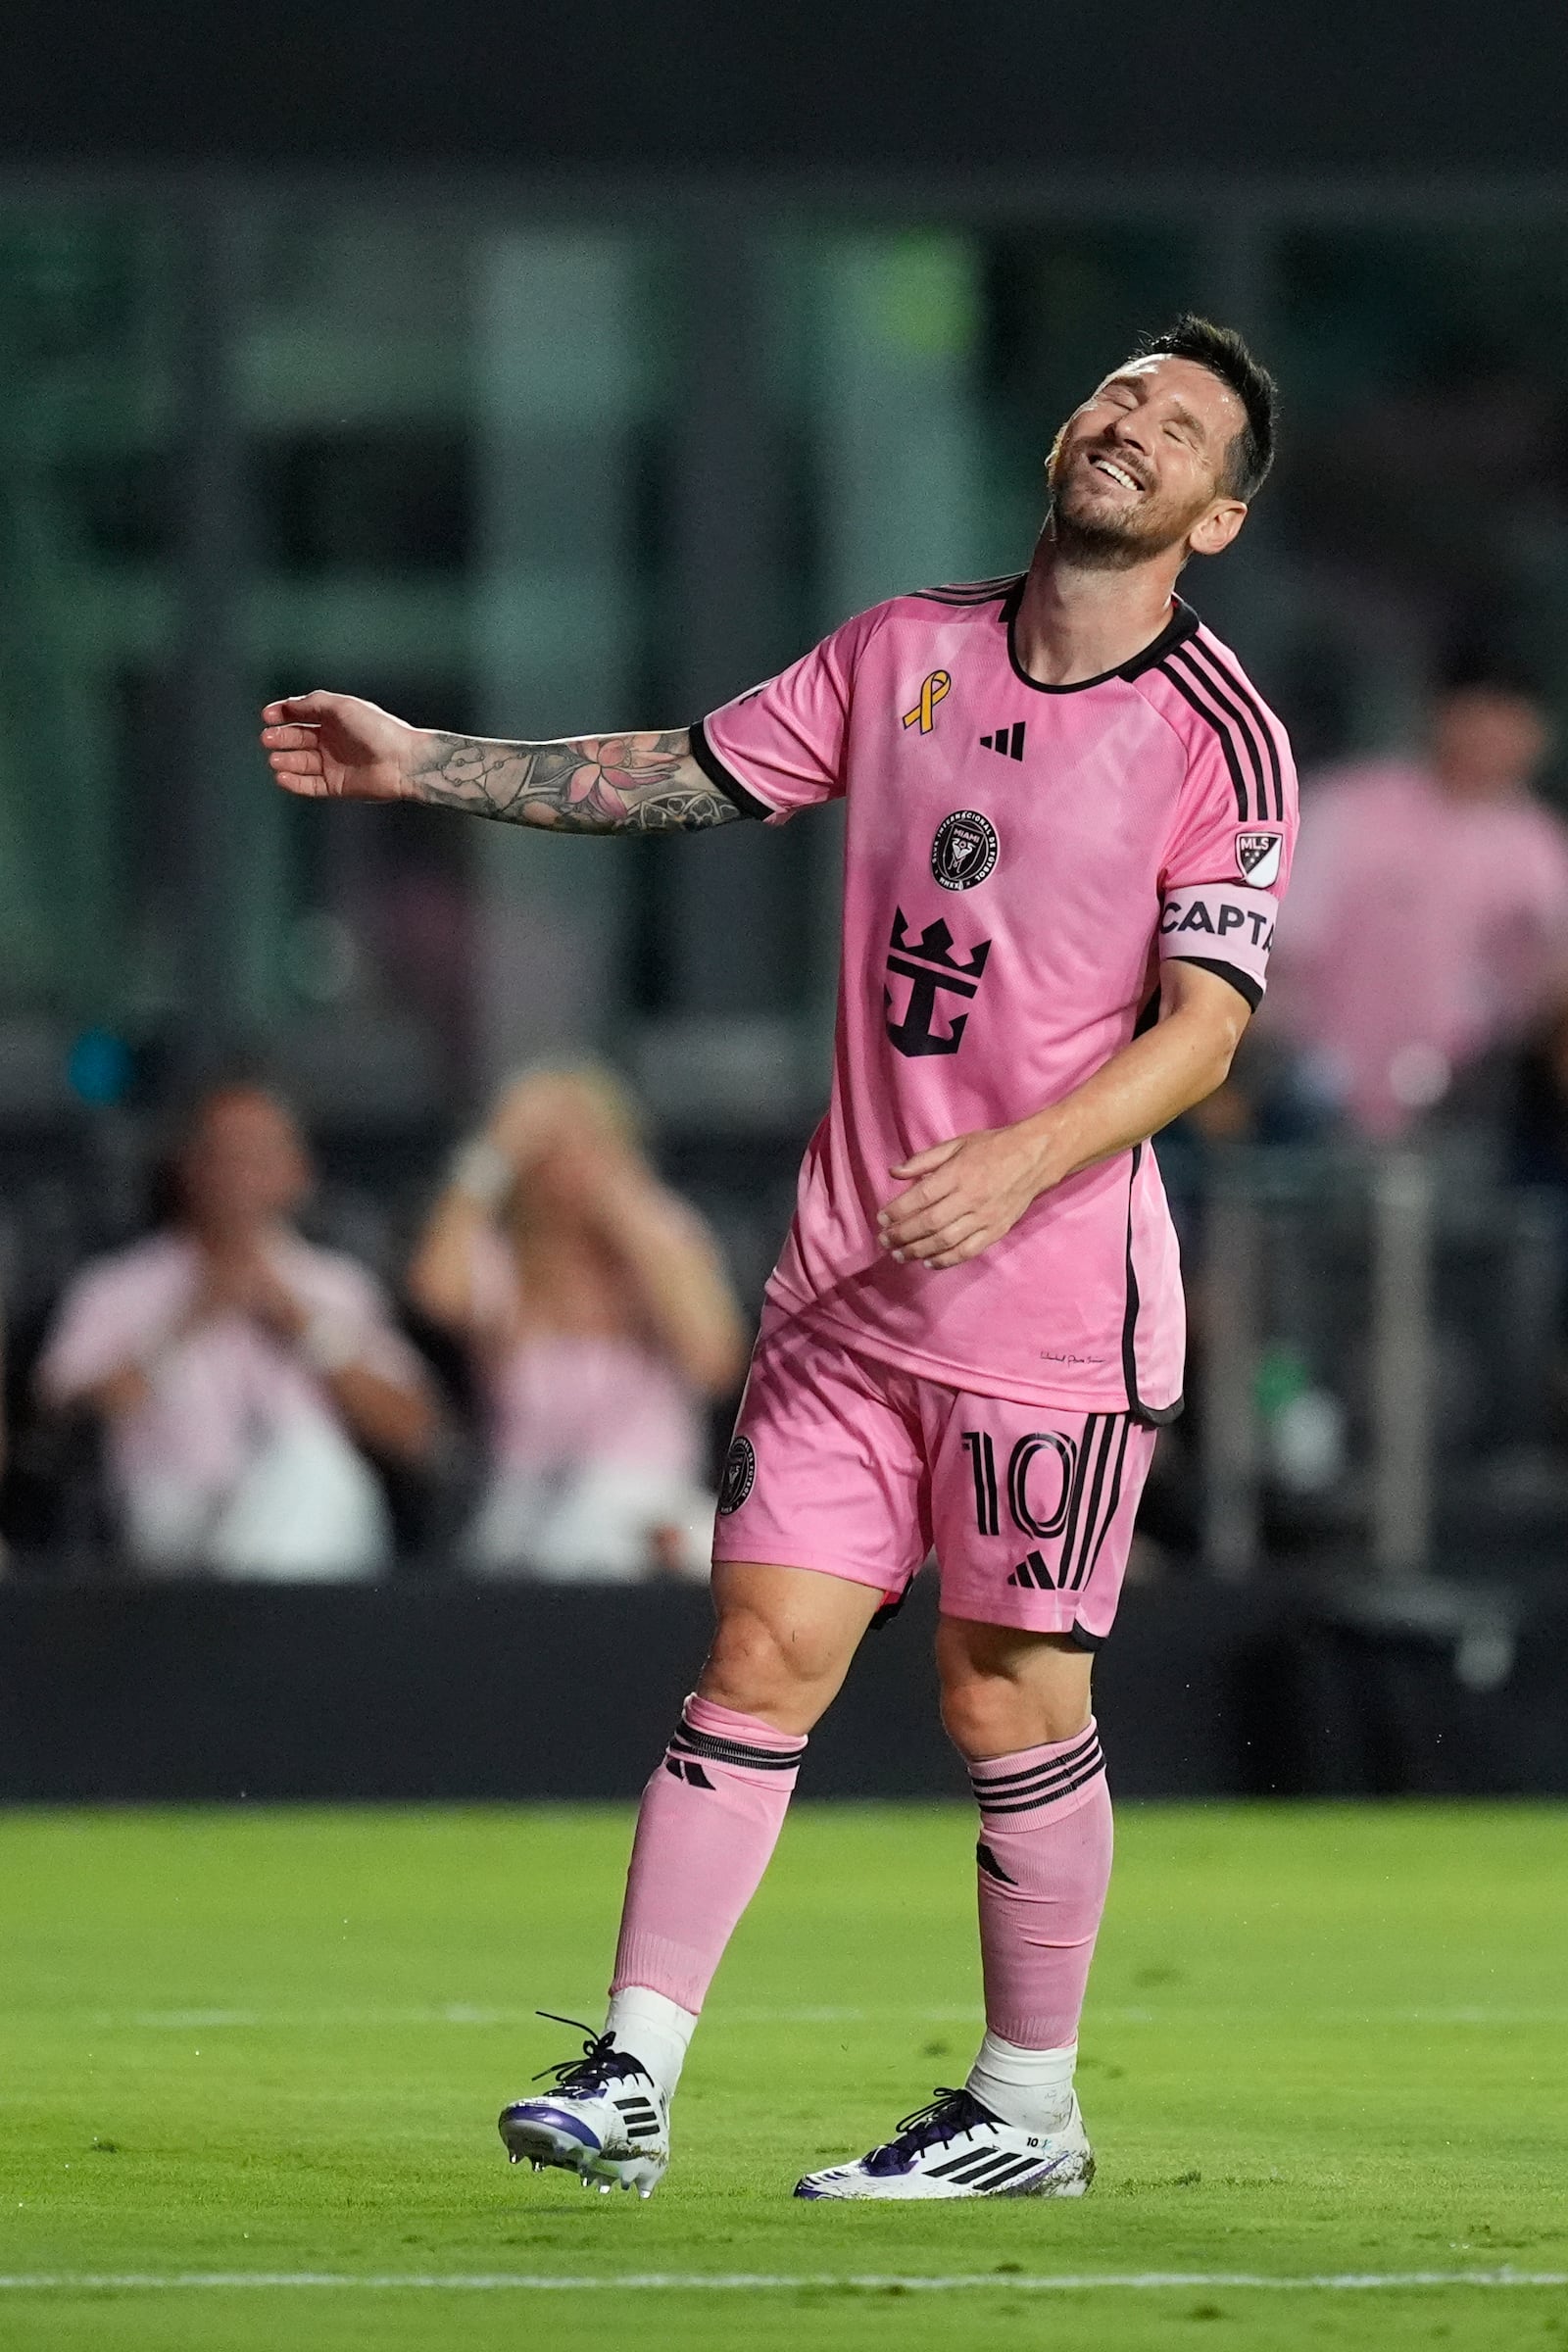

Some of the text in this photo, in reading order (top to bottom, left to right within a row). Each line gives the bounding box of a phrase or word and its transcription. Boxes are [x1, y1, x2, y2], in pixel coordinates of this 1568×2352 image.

[954, 828, 980, 844] MIAMI
[989, 836, 996, 848] DE
[1241, 837, 1269, 851] MLS
[962, 1430, 1077, 1541] 10
[1027, 2137, 1039, 2148] 10
